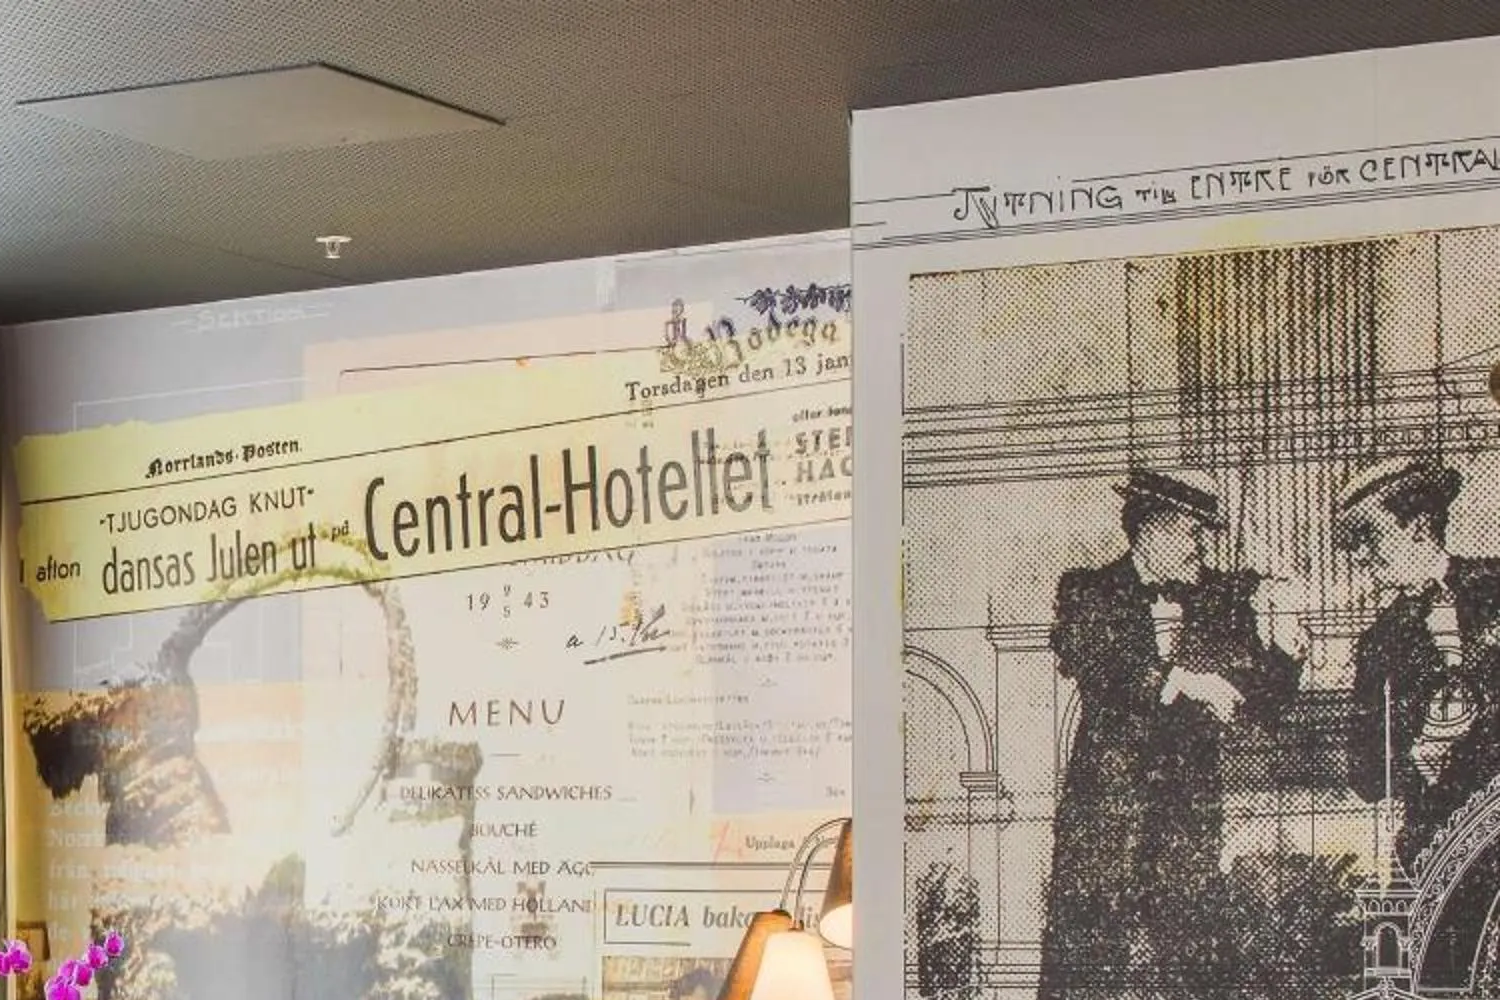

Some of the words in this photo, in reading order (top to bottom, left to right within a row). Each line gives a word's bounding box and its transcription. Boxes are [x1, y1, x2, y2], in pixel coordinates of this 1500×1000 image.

[625, 374, 729, 401] Torsdagen
[738, 363, 774, 383] den
[785, 356, 807, 378] 13
[102, 546, 196, 595] dansas
[207, 529, 277, 582] Julen
[291, 522, 317, 571] ut
[364, 427, 774, 561] Central-Hotellet
[523, 591, 550, 609] 43
[449, 699, 565, 727] MENU
[497, 784, 613, 801] SANDWICHES
[513, 861, 551, 875] MED
[469, 897, 507, 911] MED
[615, 903, 690, 928] LUCIA
